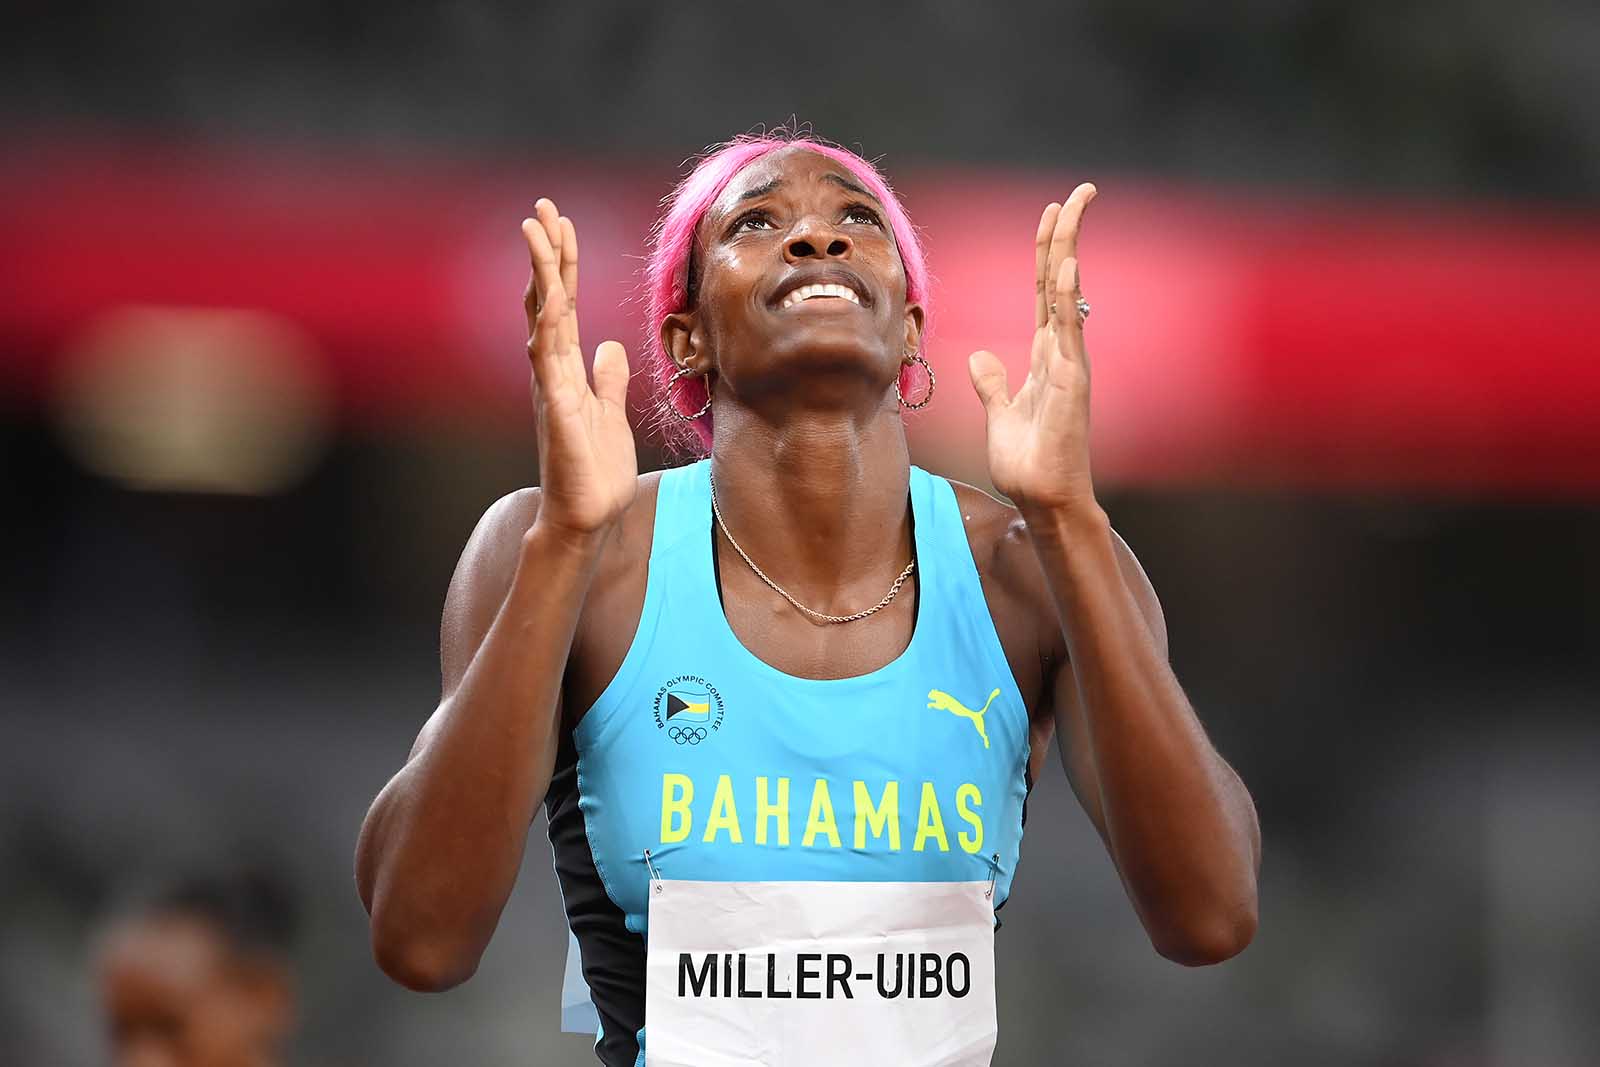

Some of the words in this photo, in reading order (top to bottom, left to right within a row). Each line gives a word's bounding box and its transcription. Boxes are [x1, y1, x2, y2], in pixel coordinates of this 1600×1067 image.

[653, 686, 667, 729] BAHAMAS
[666, 675, 705, 688] OLYMPIC
[705, 682, 725, 732] COMMITTEE
[660, 773, 984, 854] BAHAMAS
[678, 952, 970, 999] MILLER-UIBO
